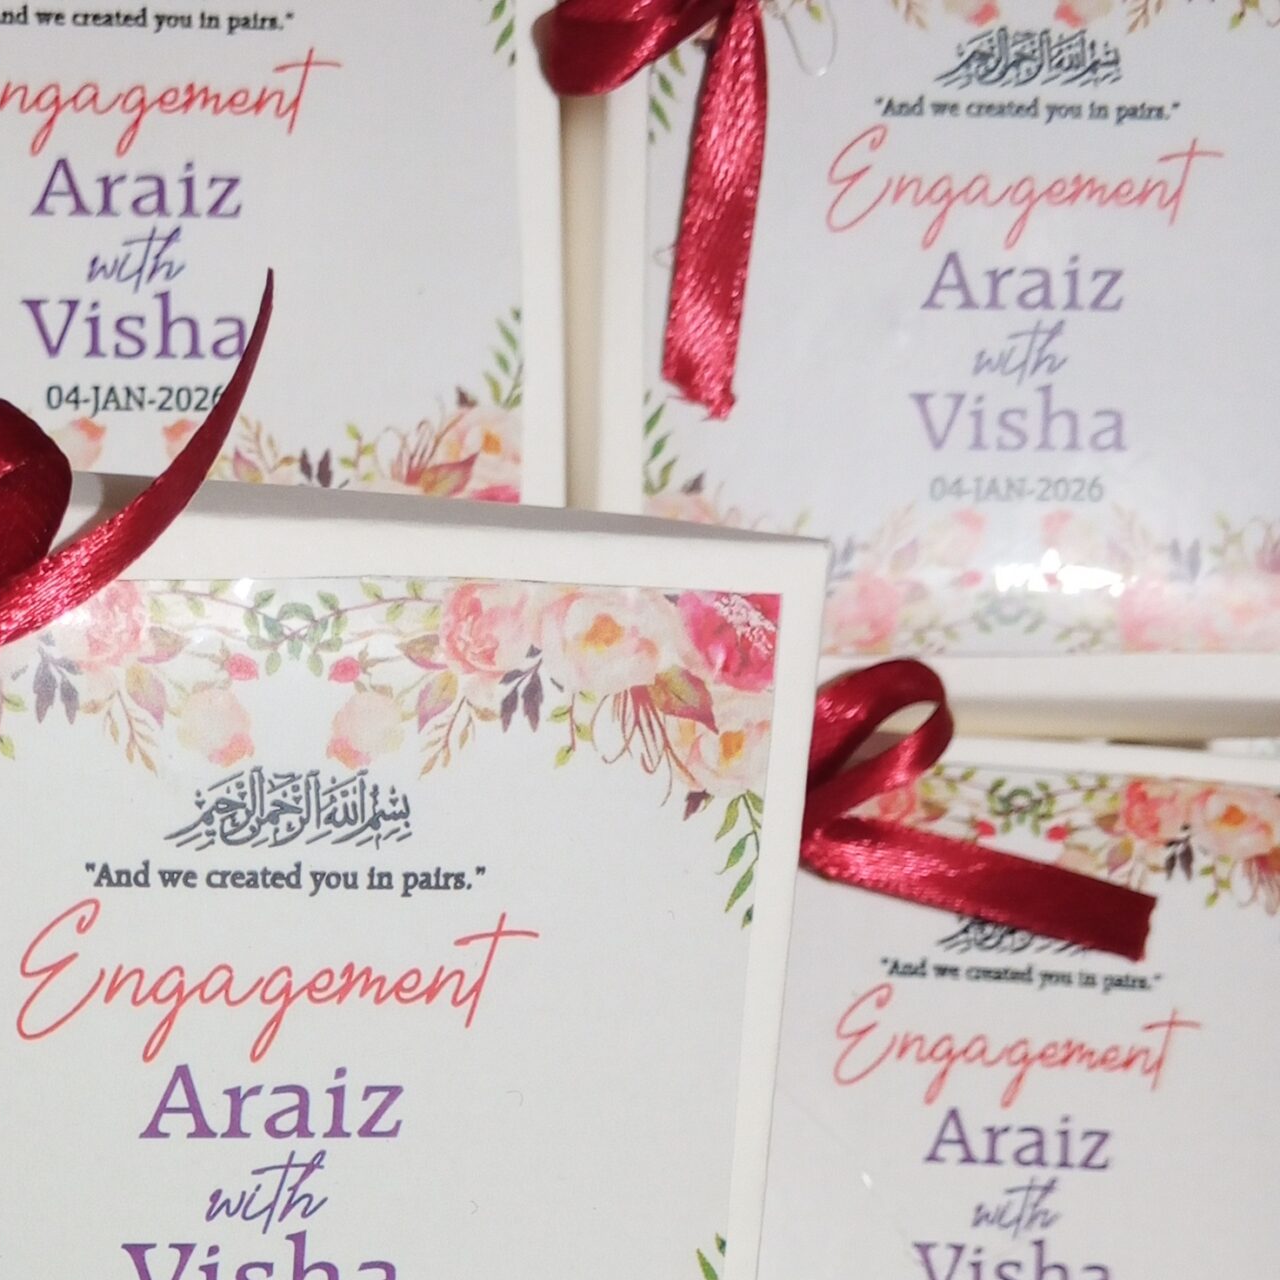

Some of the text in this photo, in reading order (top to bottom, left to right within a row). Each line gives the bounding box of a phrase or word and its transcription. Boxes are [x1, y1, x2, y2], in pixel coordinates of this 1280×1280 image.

[35, 11, 65, 26] we
[72, 8, 147, 28] created
[154, 13, 192, 33] you
[199, 12, 219, 29] in
[227, 13, 294, 34] pairs."
[874, 96, 1180, 126] "And we created you in pairs."
[30, 157, 242, 218] Araiz
[825, 123, 1224, 250] Engagement
[87, 226, 186, 293] with
[920, 251, 1125, 312] Araiz
[22, 290, 247, 359] Visha
[971, 318, 1069, 386] with
[908, 384, 1128, 453] Visha
[929, 475, 1104, 502] 04-JAN-2026
[85, 860, 486, 898] "And we created you in pairs."
[16, 897, 540, 1064] Engagement
[833, 981, 1202, 1108] Engagement
[138, 1063, 404, 1140] Araiz
[924, 1107, 1111, 1171] Araiz
[205, 1149, 328, 1234] with
[972, 1177, 1059, 1240] with
